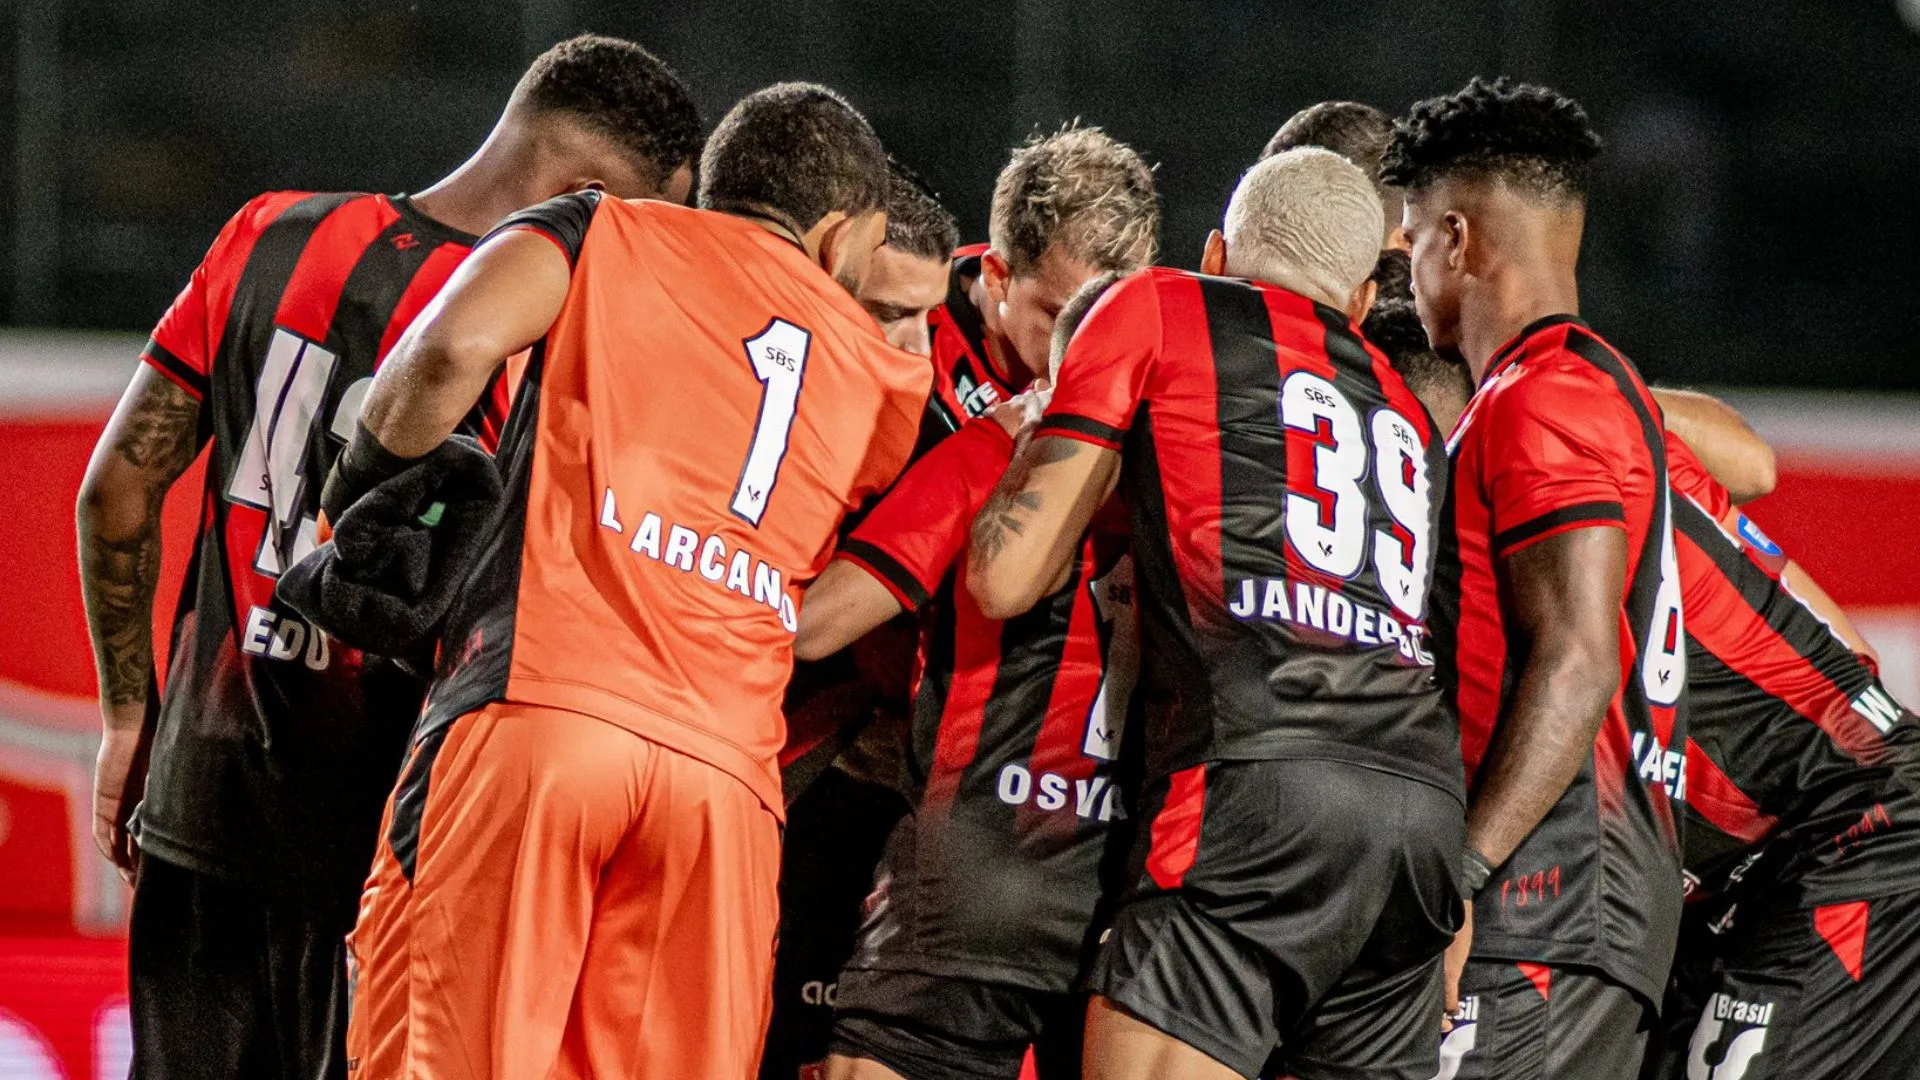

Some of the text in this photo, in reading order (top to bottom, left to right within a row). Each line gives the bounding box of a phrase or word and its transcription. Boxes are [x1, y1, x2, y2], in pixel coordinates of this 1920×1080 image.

[764, 345, 795, 373] SBS
[729, 316, 811, 529] 1
[1304, 386, 1336, 408] SBS
[1278, 368, 1434, 622] 39
[629, 510, 798, 633] ARCANO
[242, 605, 330, 671] EDU
[1500, 864, 1561, 908] 1899
[1716, 993, 1774, 1026] Brasil
